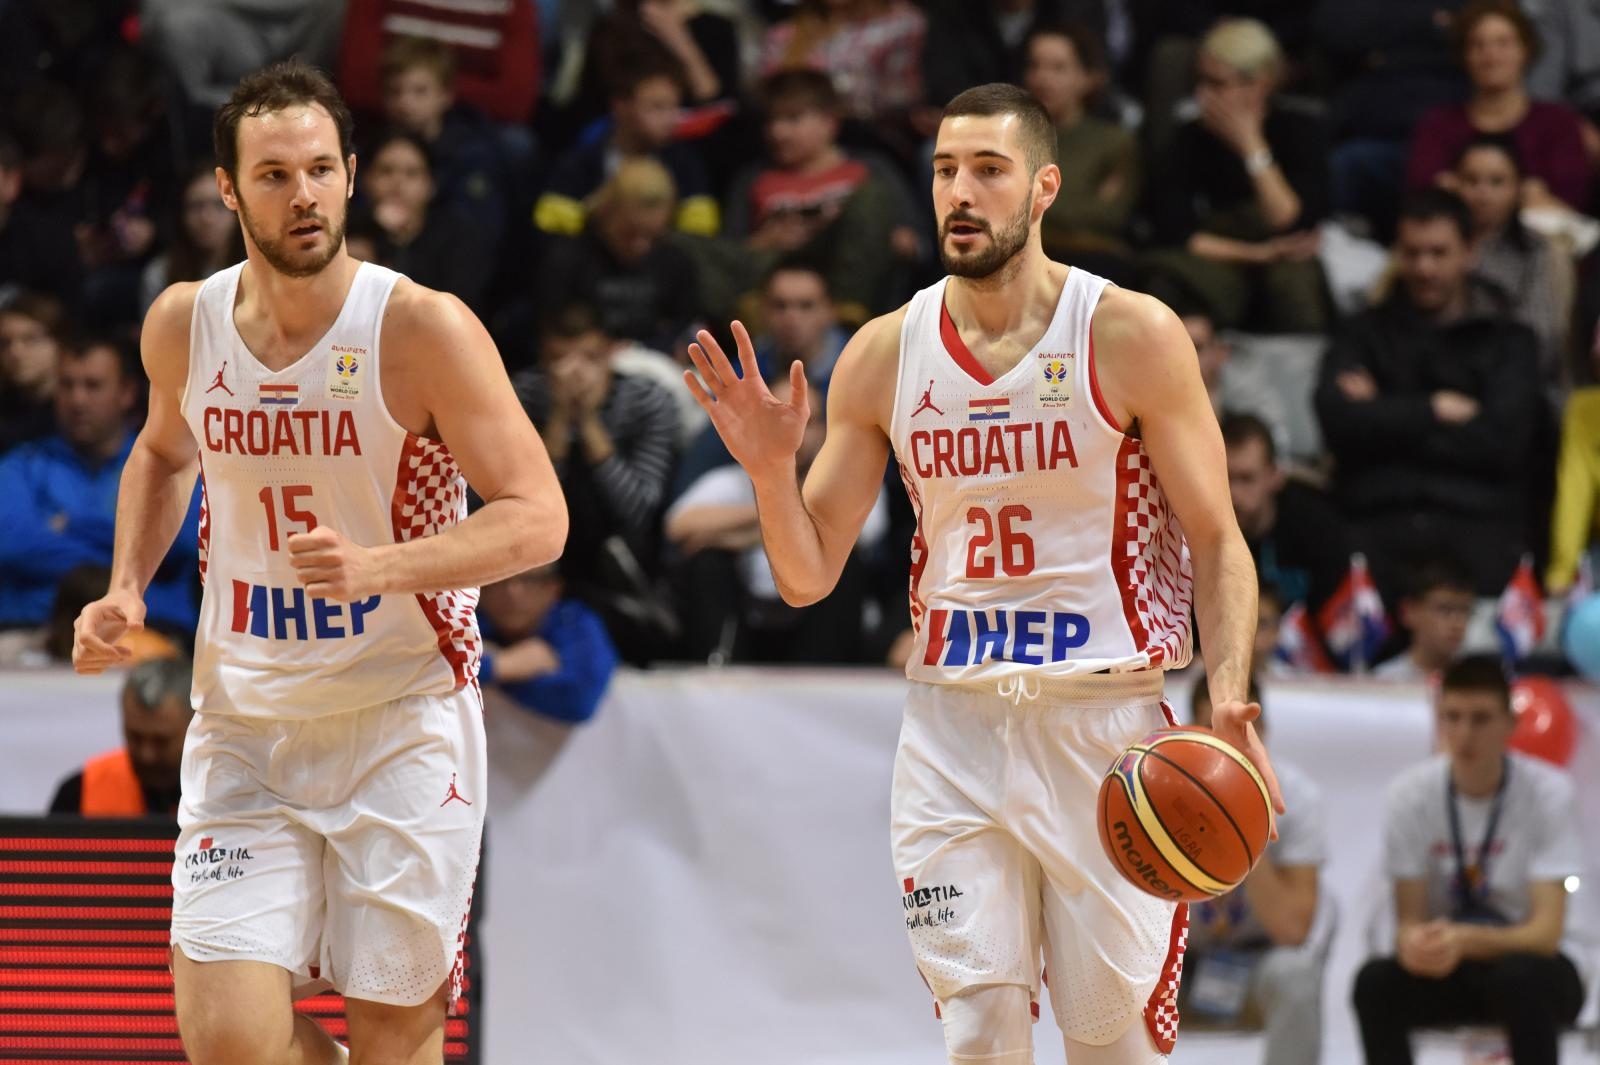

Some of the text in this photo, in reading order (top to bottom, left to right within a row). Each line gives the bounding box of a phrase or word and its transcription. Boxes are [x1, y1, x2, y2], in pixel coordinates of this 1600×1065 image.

[203, 406, 362, 456] CROATIA
[910, 420, 1079, 479] CROATIA
[258, 485, 318, 551] 15
[966, 504, 1035, 578] 26
[271, 588, 382, 641] HEP
[973, 610, 1091, 666] HEP
[185, 847, 255, 869] CROATIA
[1113, 820, 1184, 898] molten
[902, 884, 964, 911] ROATIA
[938, 907, 955, 923] life
